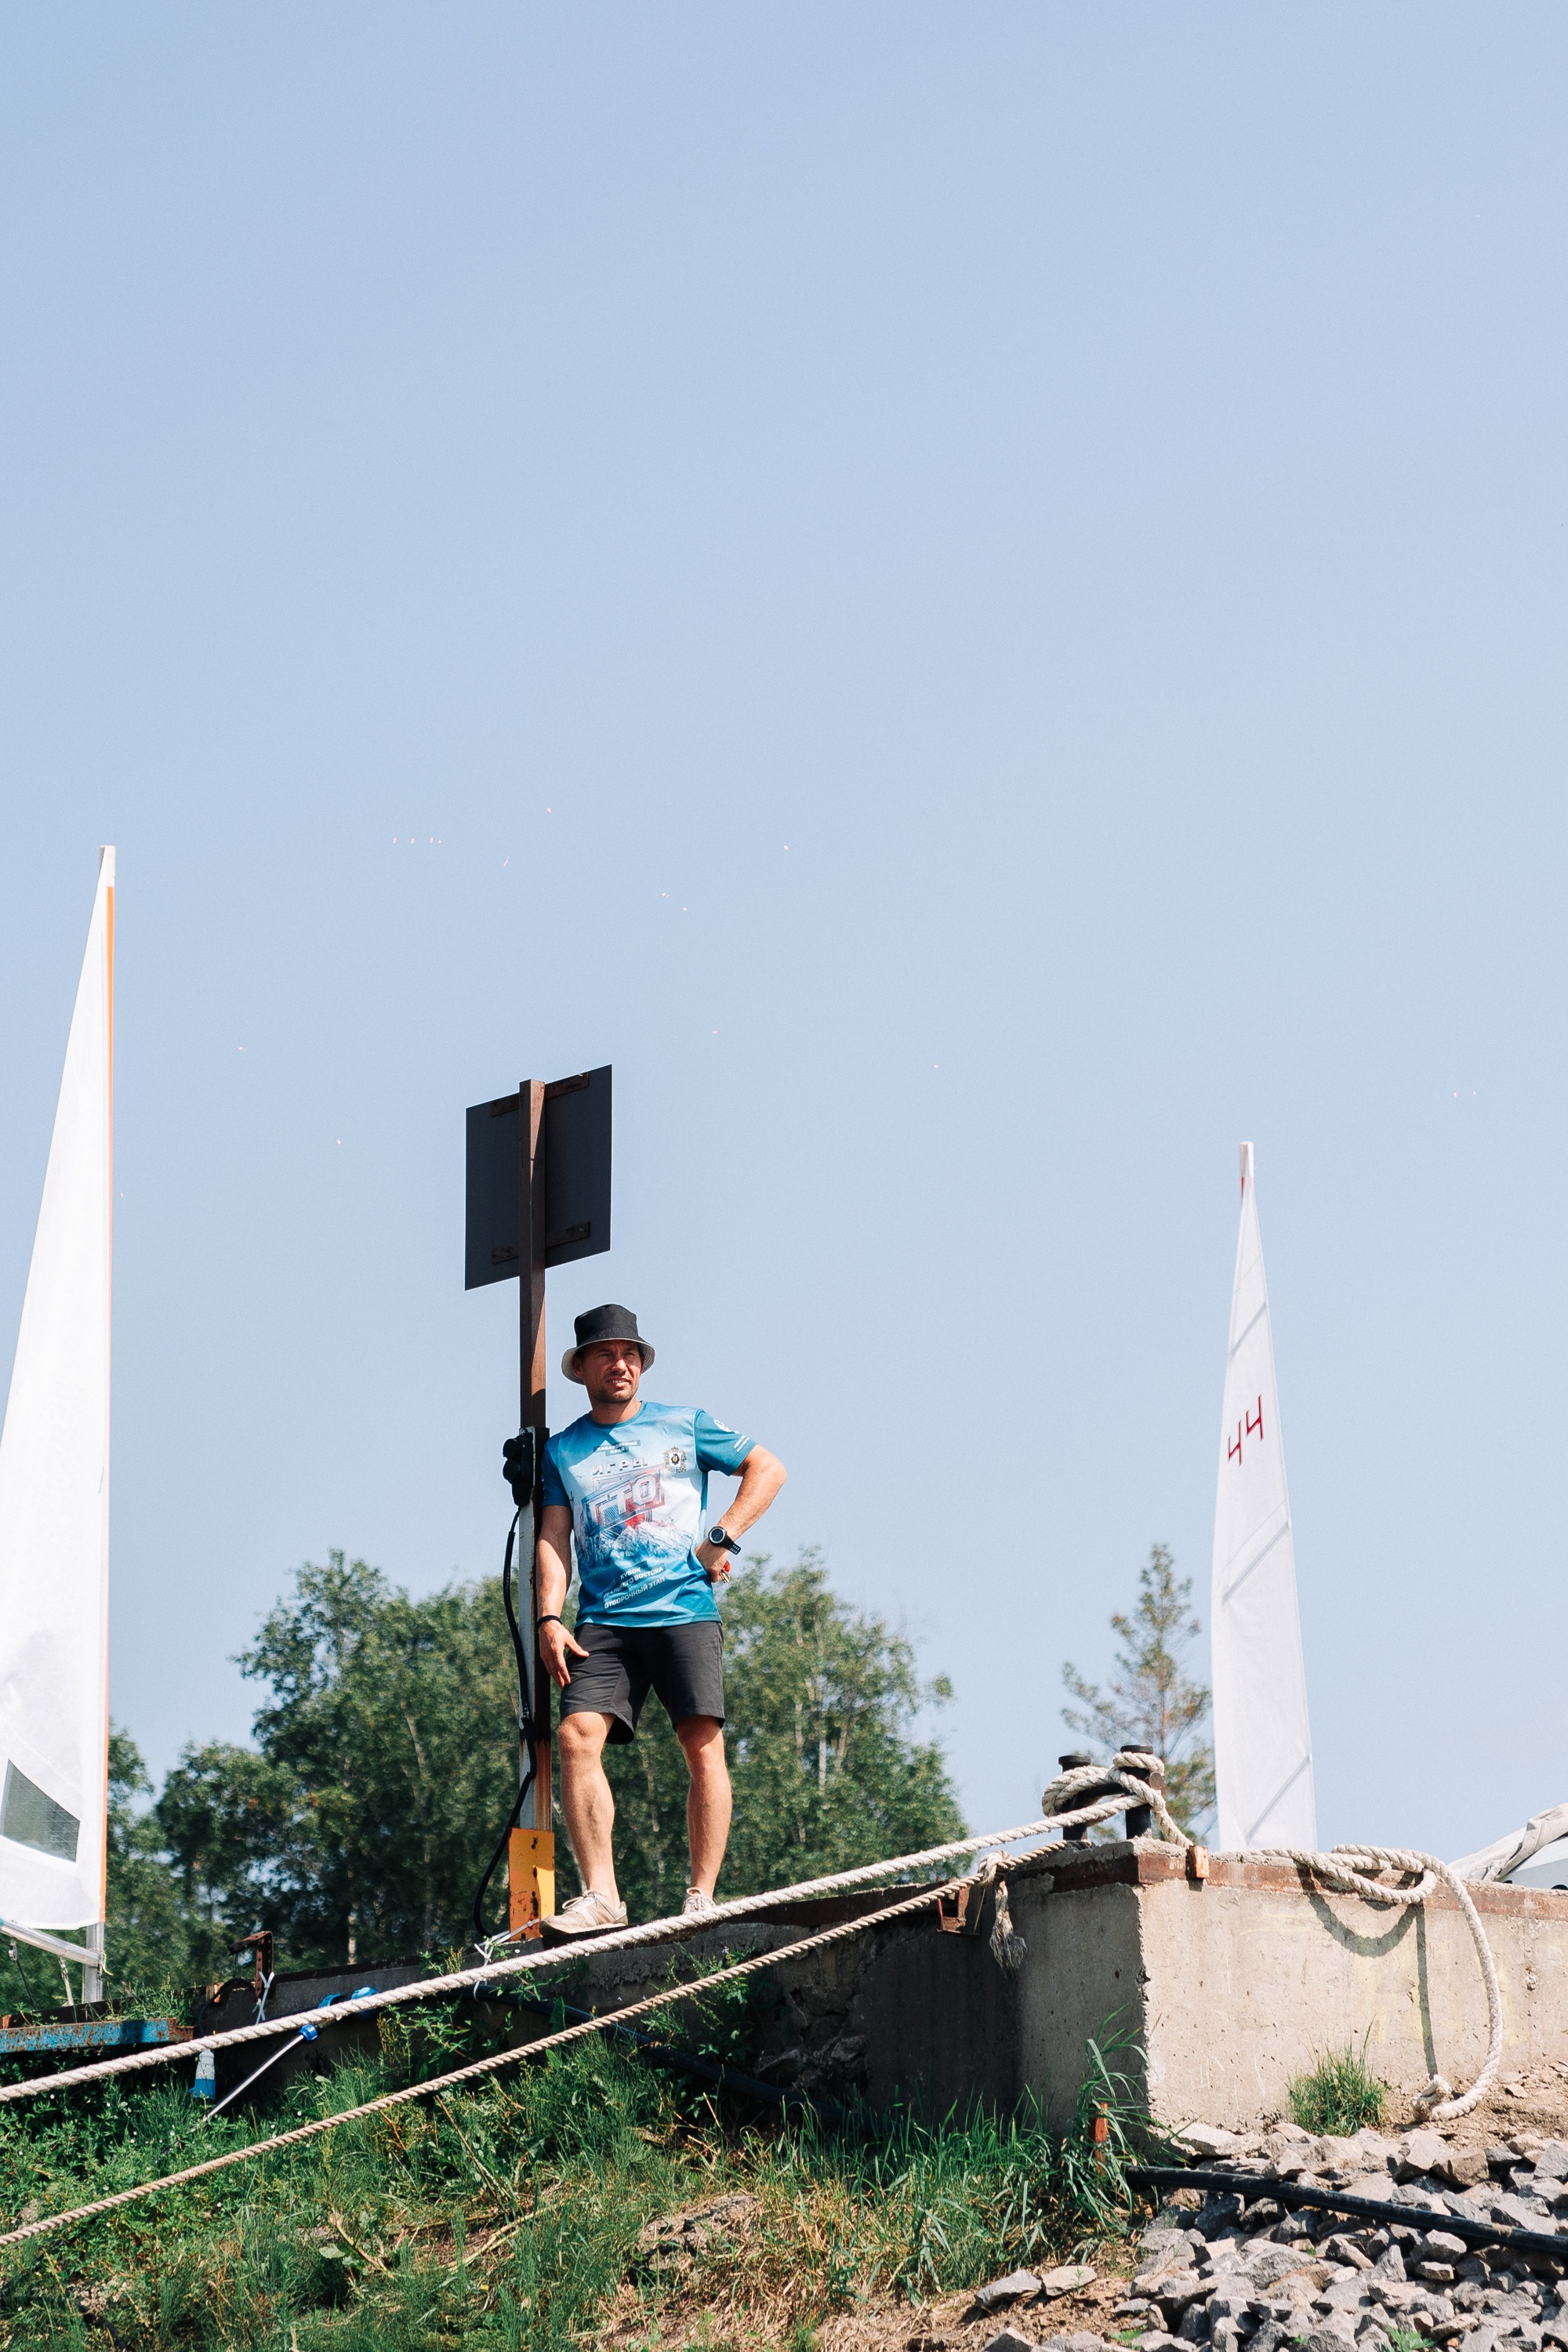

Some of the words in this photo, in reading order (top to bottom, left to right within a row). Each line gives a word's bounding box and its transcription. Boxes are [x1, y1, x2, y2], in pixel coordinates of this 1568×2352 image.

[1229, 1394, 1263, 1466] 44
[593, 1456, 648, 1475] ИГРЫ
[586, 1475, 657, 1530] ГТО
[619, 1567, 641, 1580] КУБОК
[633, 1566, 663, 1581] ВОСТОКА
[604, 1584, 648, 1609] ОТБОРОЧНЫЙ
[648, 1576, 666, 1589] ЭТАП
